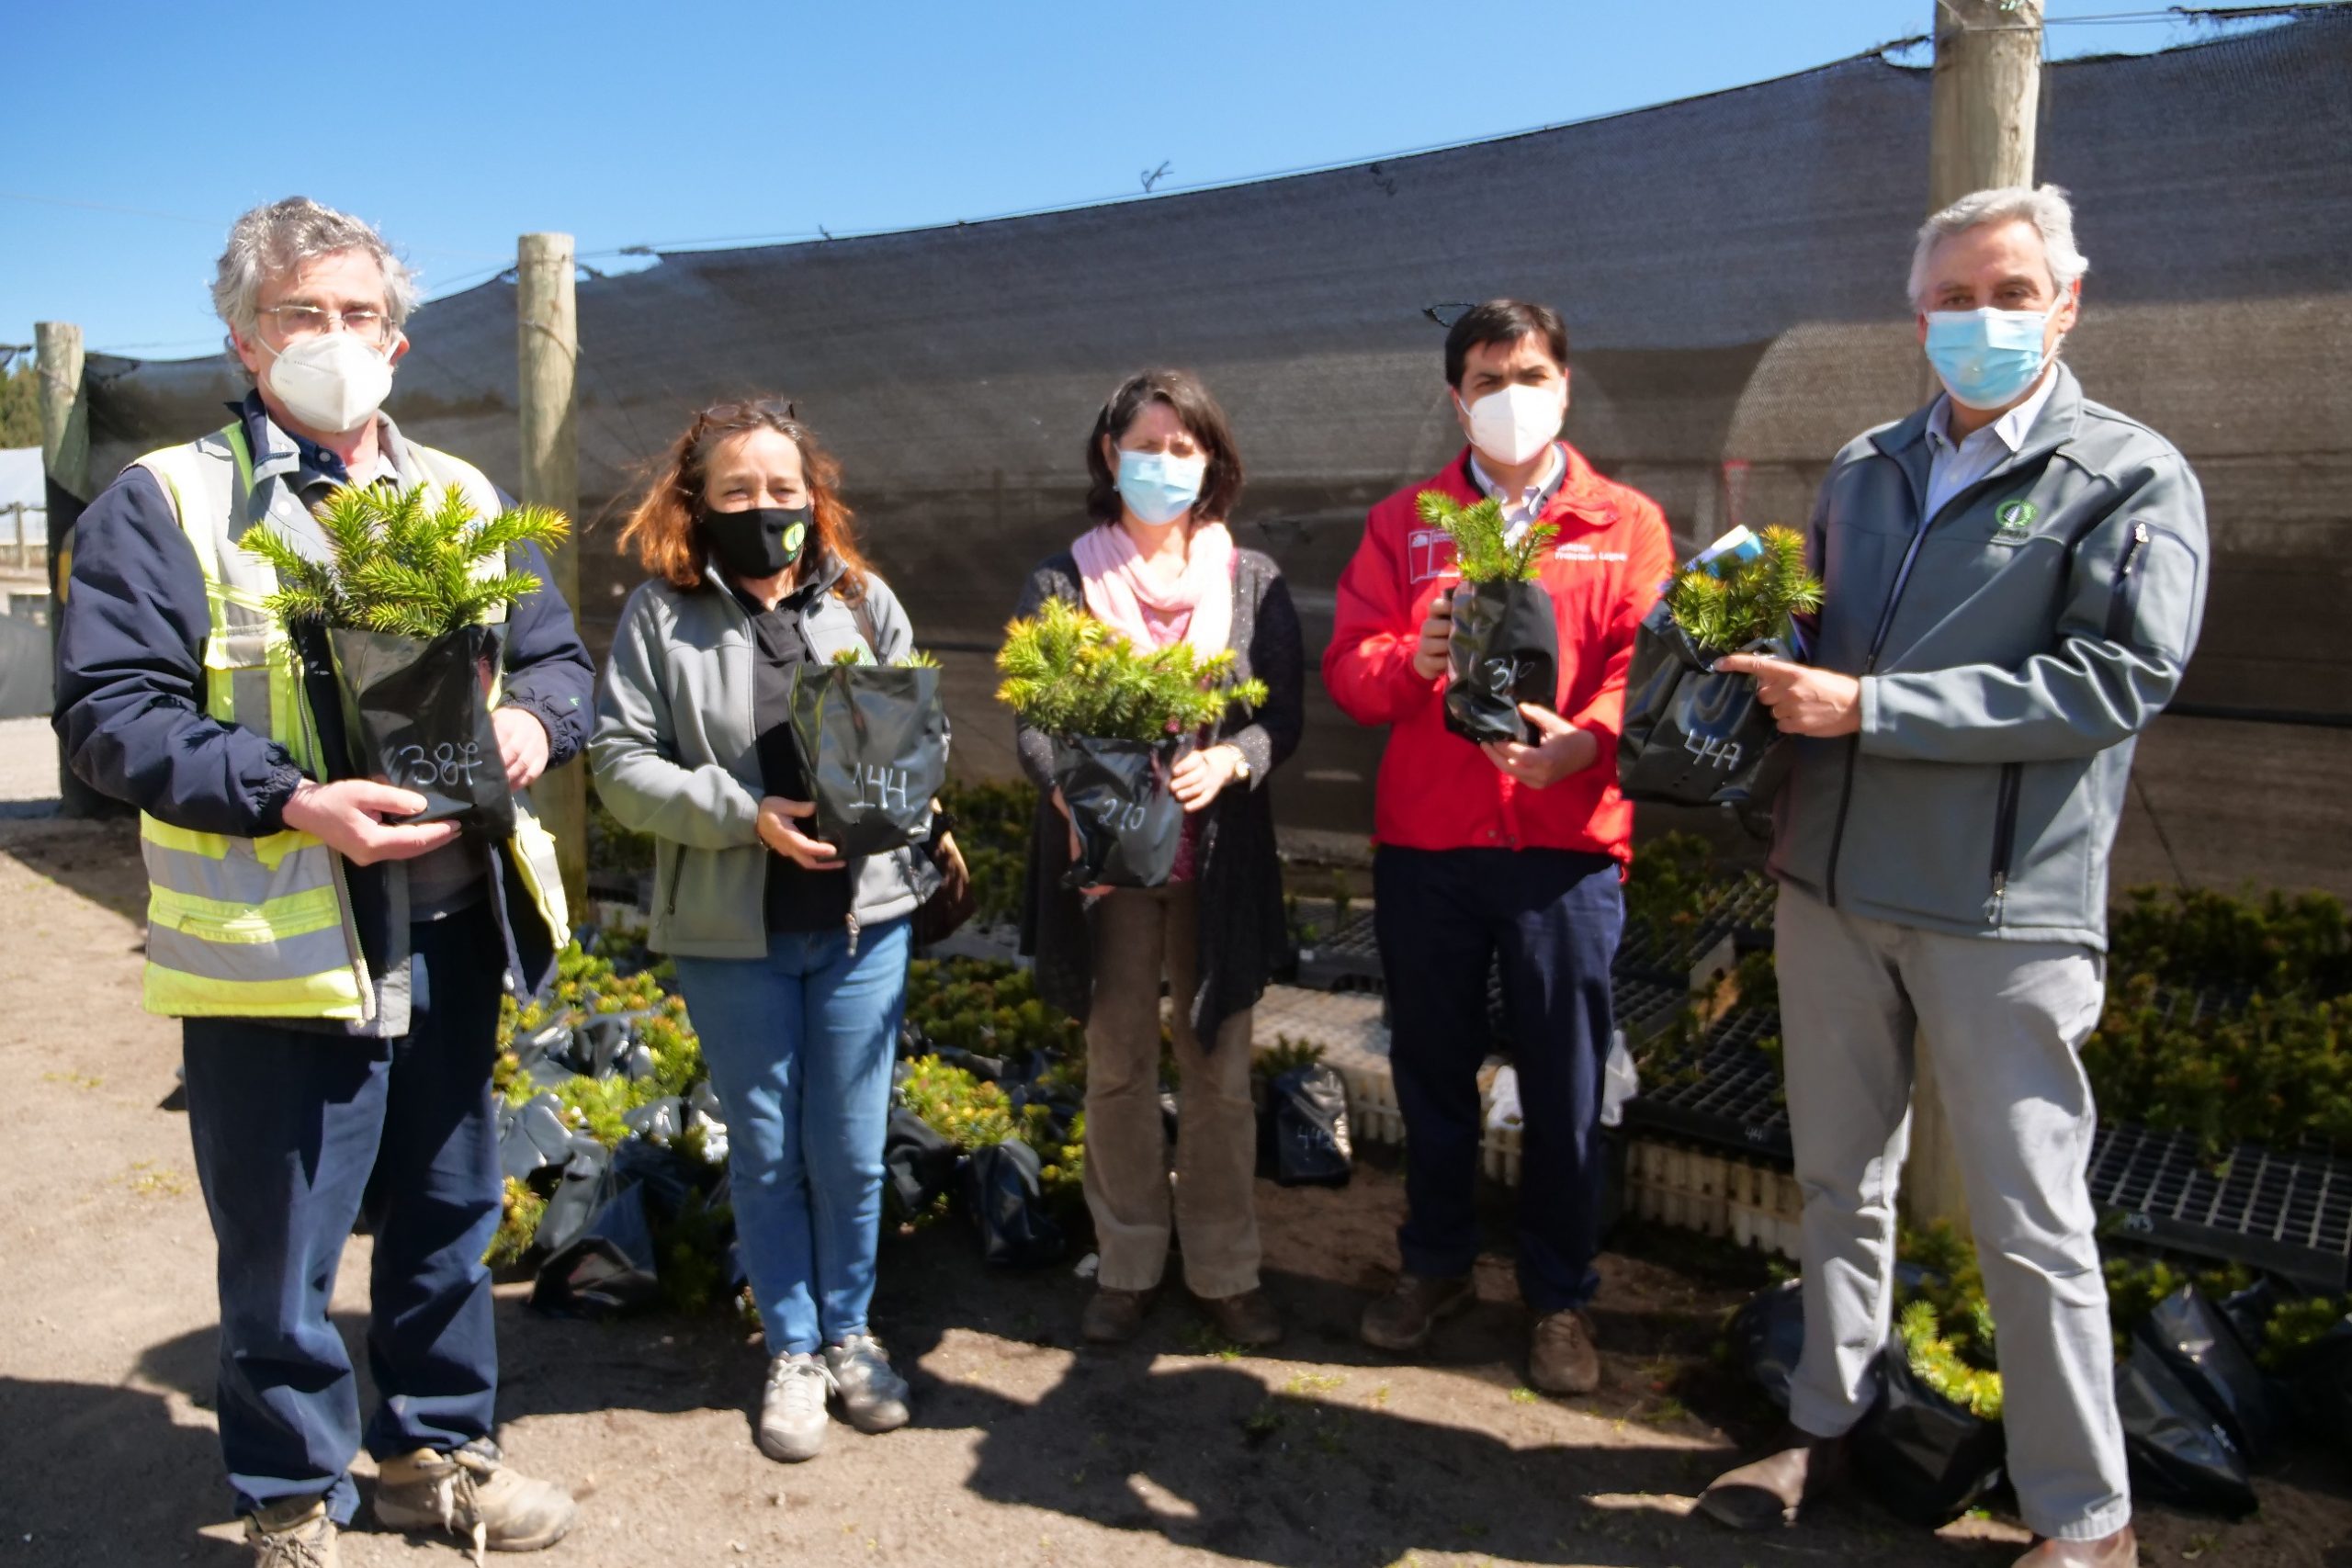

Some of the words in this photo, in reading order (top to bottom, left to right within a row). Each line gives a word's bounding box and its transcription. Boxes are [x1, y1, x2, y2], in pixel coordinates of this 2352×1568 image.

[398, 741, 483, 786] 387
[1683, 728, 1743, 772] 447
[848, 761, 908, 810] 144
